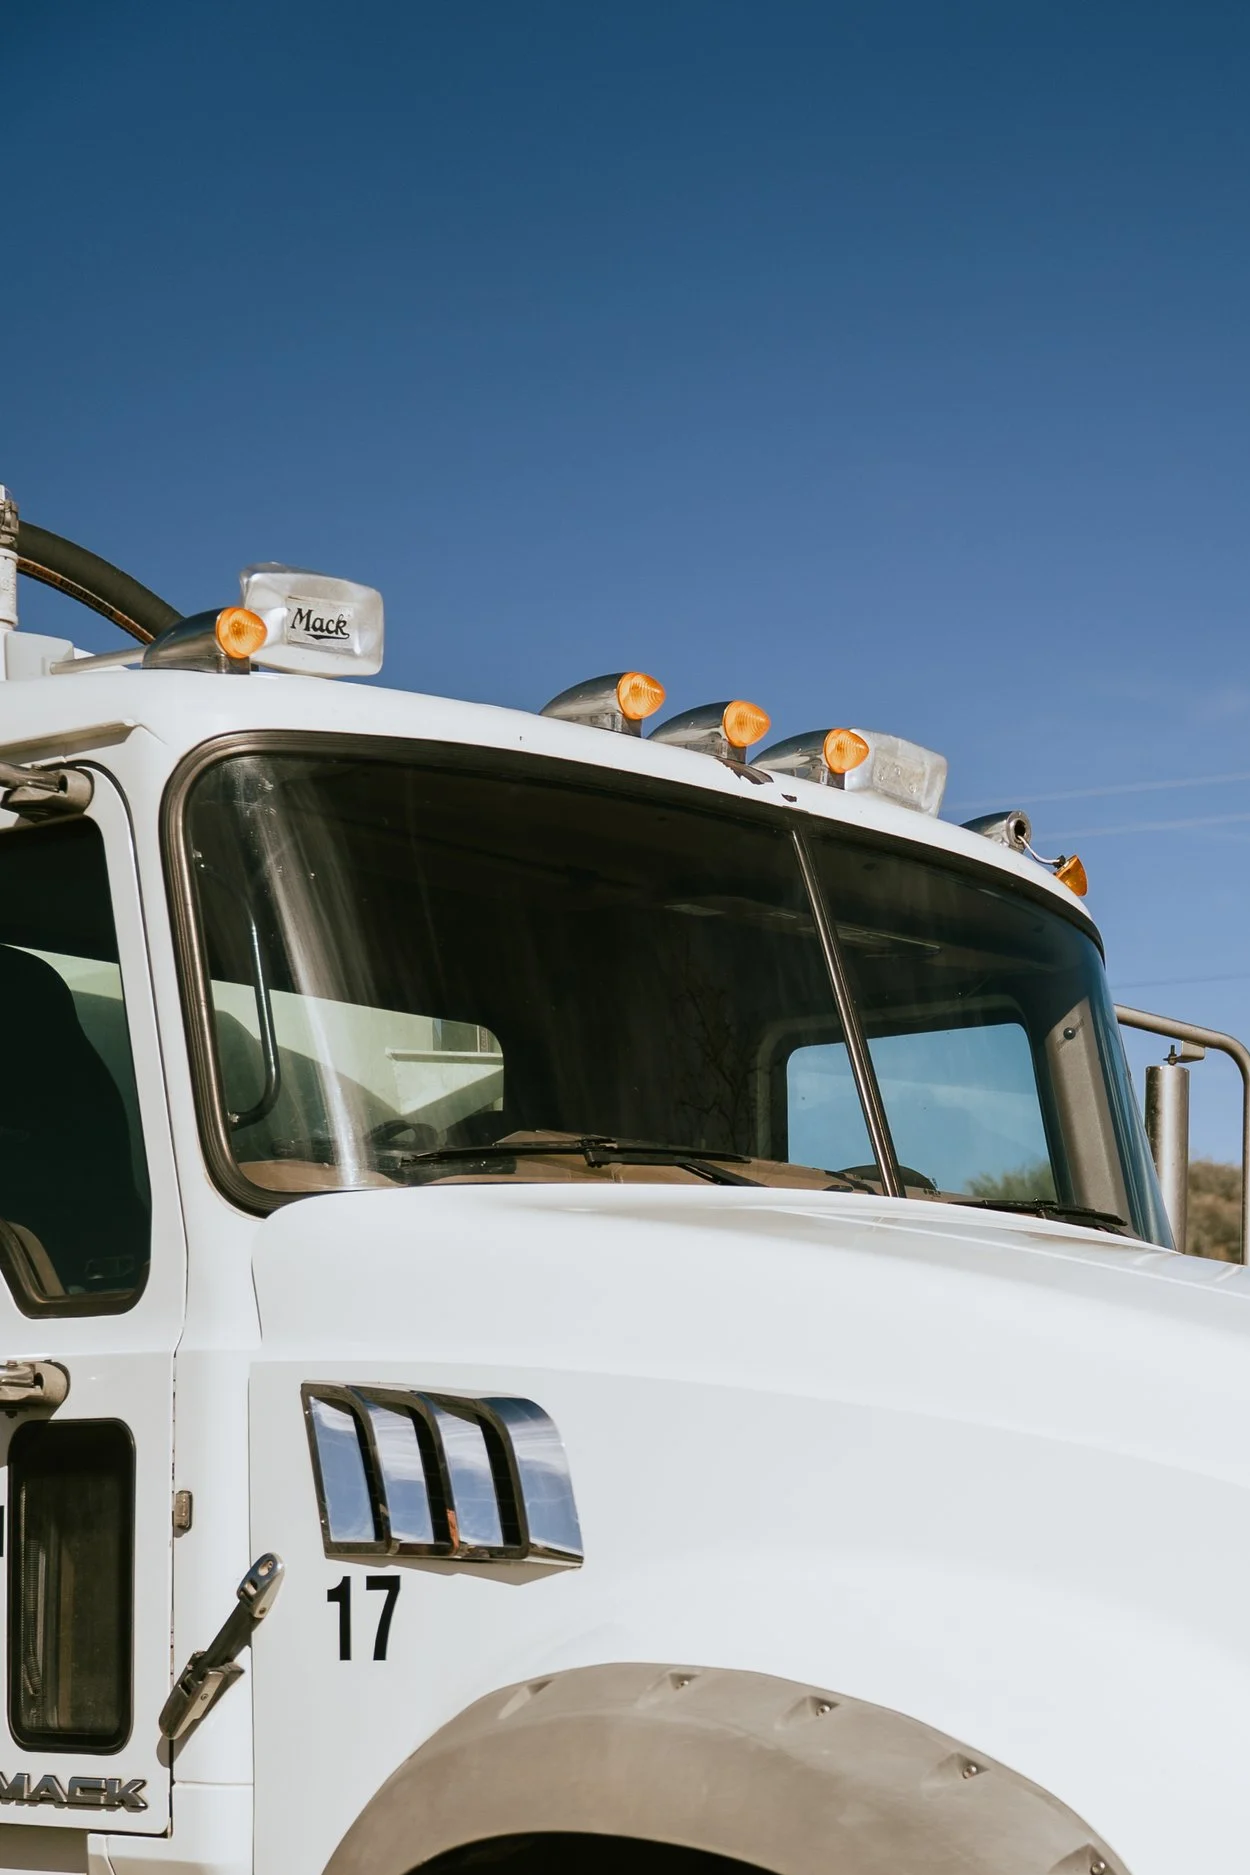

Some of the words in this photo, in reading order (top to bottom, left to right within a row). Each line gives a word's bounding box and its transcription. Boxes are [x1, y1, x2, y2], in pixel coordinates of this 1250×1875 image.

[290, 608, 350, 640] Mack
[326, 1575, 401, 1661] 17
[0, 1772, 148, 1809] MACK
